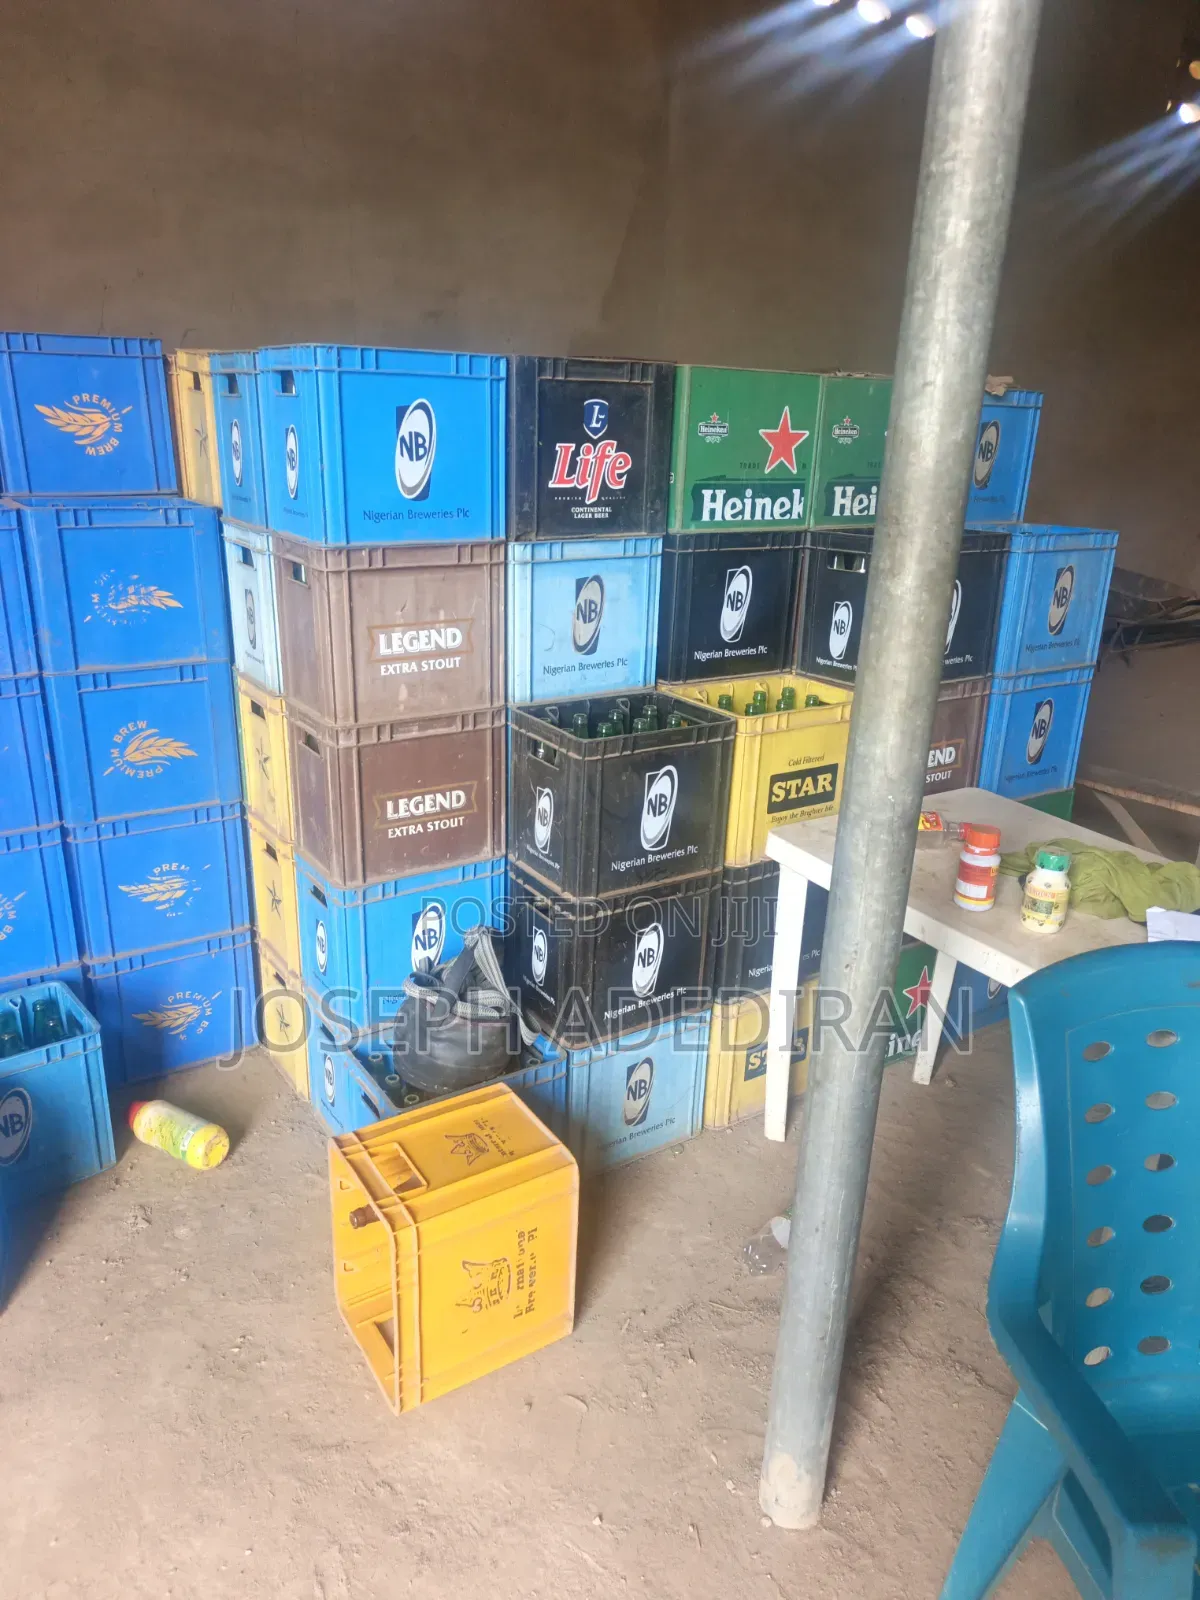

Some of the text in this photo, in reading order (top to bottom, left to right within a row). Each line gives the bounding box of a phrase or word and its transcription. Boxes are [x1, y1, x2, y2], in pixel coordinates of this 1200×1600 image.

[72, 393, 123, 456] PREMIUM BREW
[700, 425, 728, 434] Heineken
[399, 431, 428, 462] NB
[548, 440, 632, 505] Life
[832, 485, 878, 517] Hei
[363, 507, 470, 523] Nigerian Breweries Plc
[576, 598, 598, 624] NB
[726, 590, 744, 612] NB
[833, 618, 846, 636] NB
[379, 627, 463, 656] LEGEND
[694, 645, 768, 662] Nigerian Breweries Plc
[962, 654, 973, 662] Plc
[380, 656, 462, 676] EXTRA STOUT
[543, 657, 628, 676] Nigerian Breweries Plc
[110, 720, 164, 779] BREW PREMIUM
[927, 746, 956, 768] END
[771, 773, 833, 803] STAR
[925, 770, 952, 784] STOUT
[386, 790, 467, 820] LEGEND
[647, 796, 668, 817] NB
[388, 816, 465, 839] EXTRA STOUT
[611, 844, 699, 872] Nigerian Breweries Plc
[415, 929, 439, 951] NB
[637, 947, 655, 968] NB
[167, 991, 213, 1016] PREMIUM
[603, 987, 687, 1020] Nigerian Breweries Plc
[627, 1079, 648, 1101] NB
[629, 1122, 664, 1140] Breweries
[665, 1117, 676, 1126] Plc
